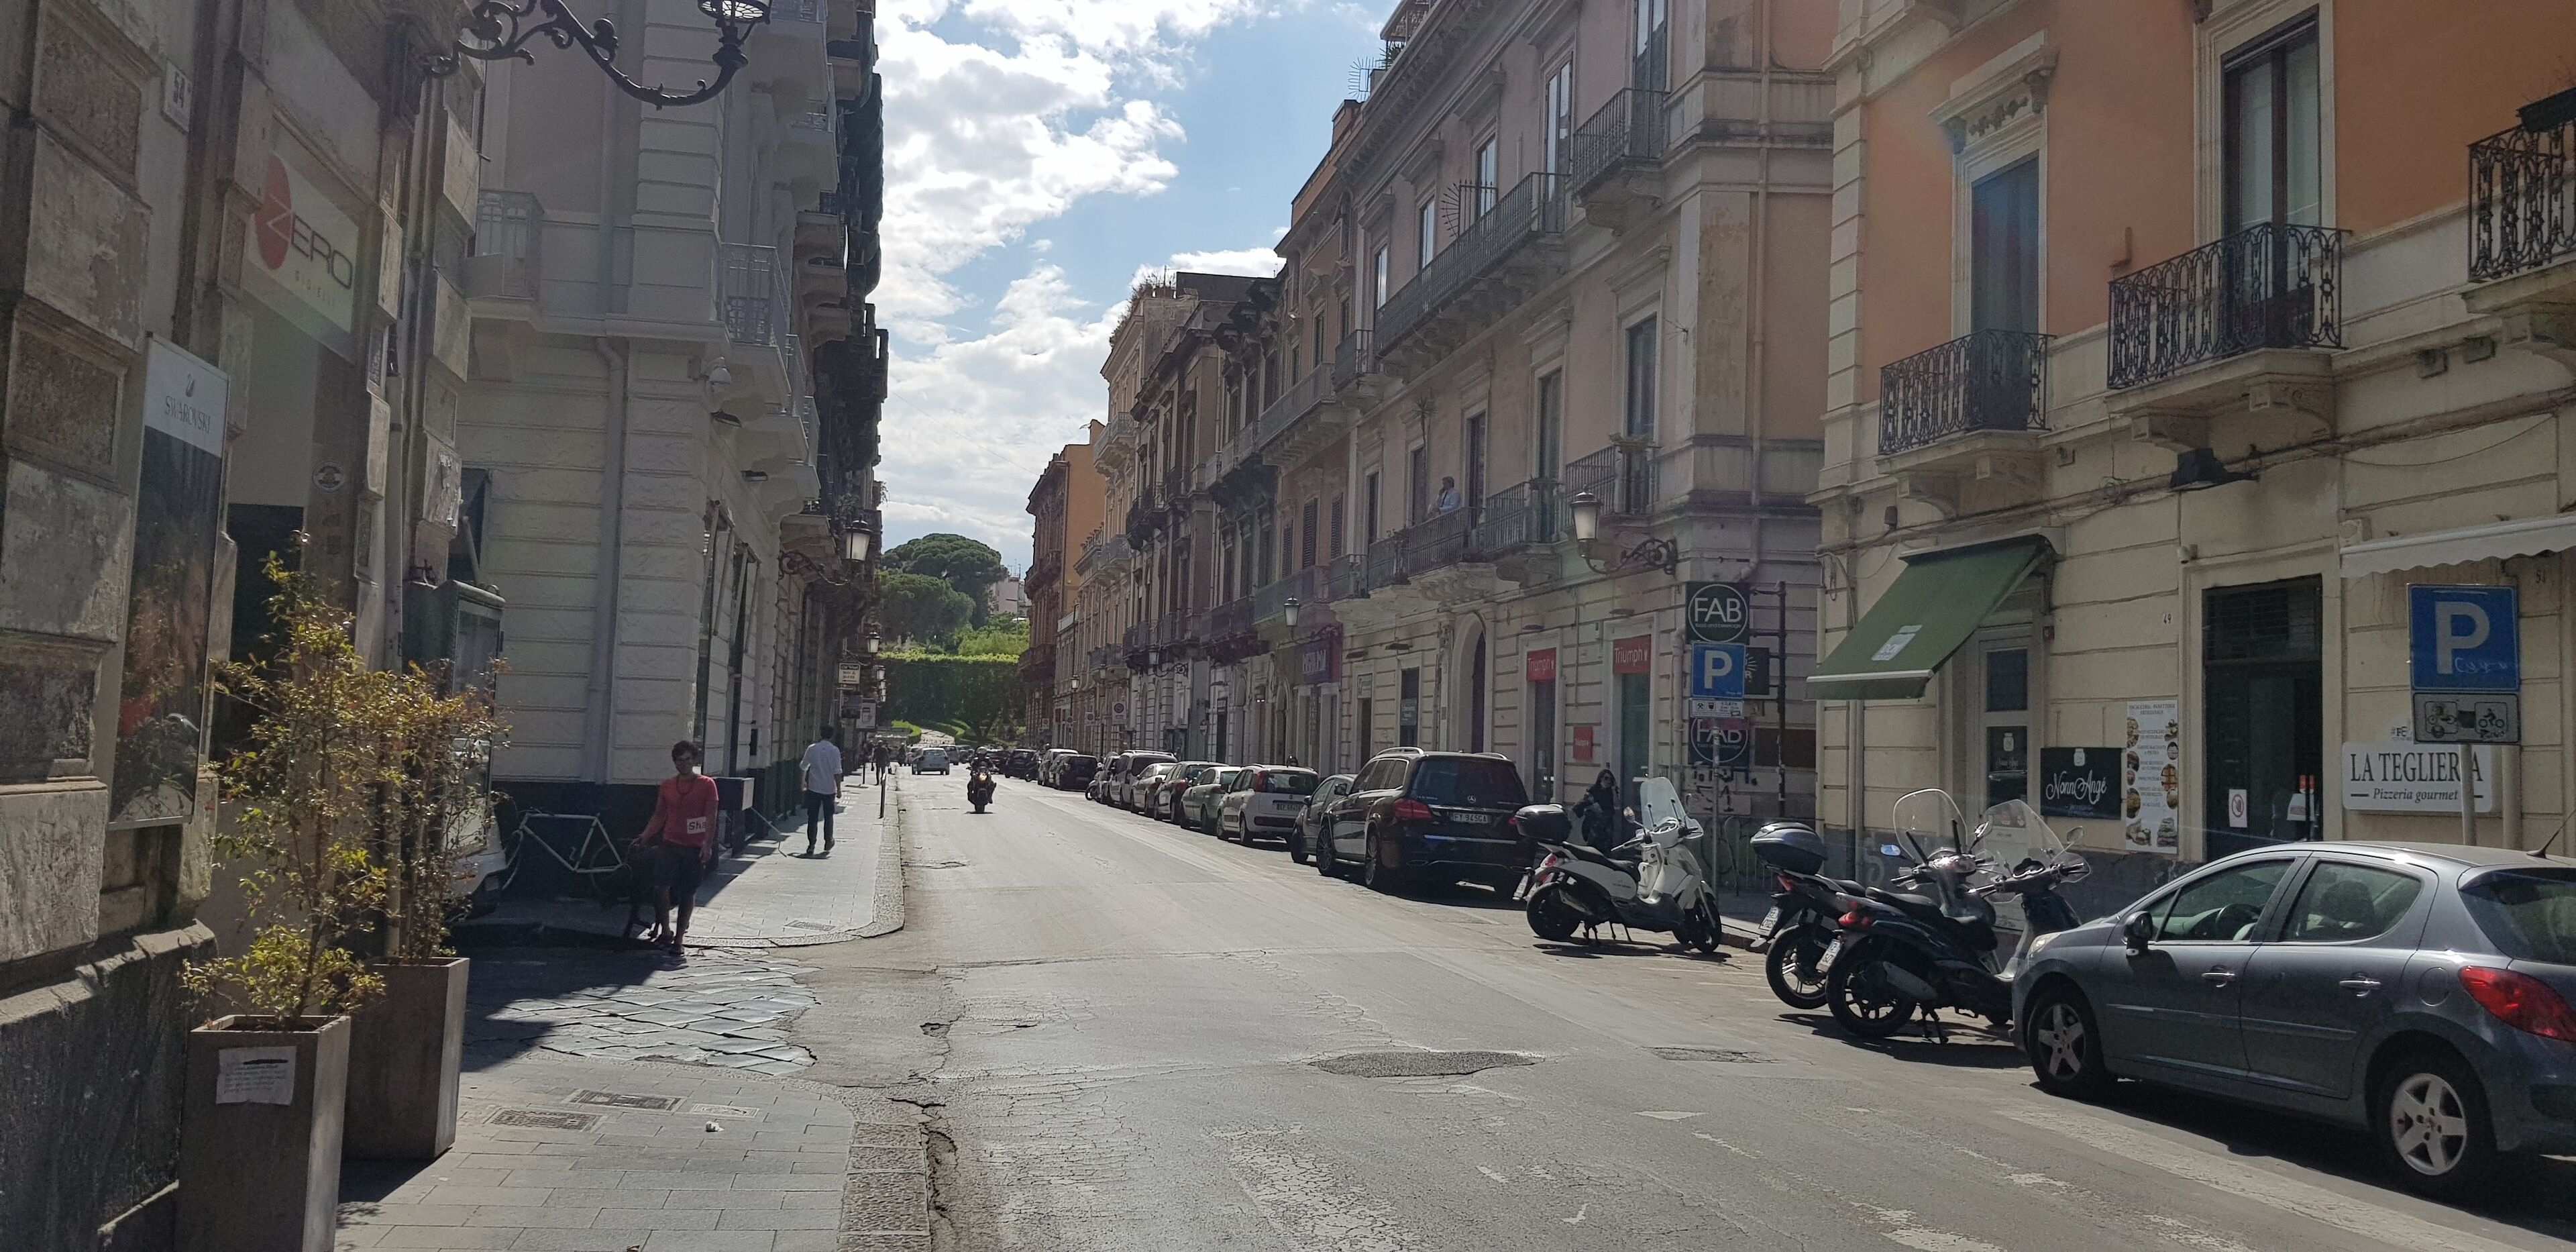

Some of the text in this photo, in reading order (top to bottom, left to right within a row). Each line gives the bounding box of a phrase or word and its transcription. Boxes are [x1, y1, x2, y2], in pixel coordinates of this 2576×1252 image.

[267, 193, 352, 290] ZERO
[164, 395, 211, 433] SWAROVSKI
[1695, 597, 1742, 623] FAB
[2163, 613, 2171, 625] 49
[2434, 601, 2491, 675] P
[1527, 657, 1551, 675] Triumph
[1614, 645, 1643, 667] Triumph
[1704, 649, 1733, 689] P
[2350, 751, 2483, 782] LA TEGLIERA
[2373, 788, 2459, 803] Pizzeria gourmet
